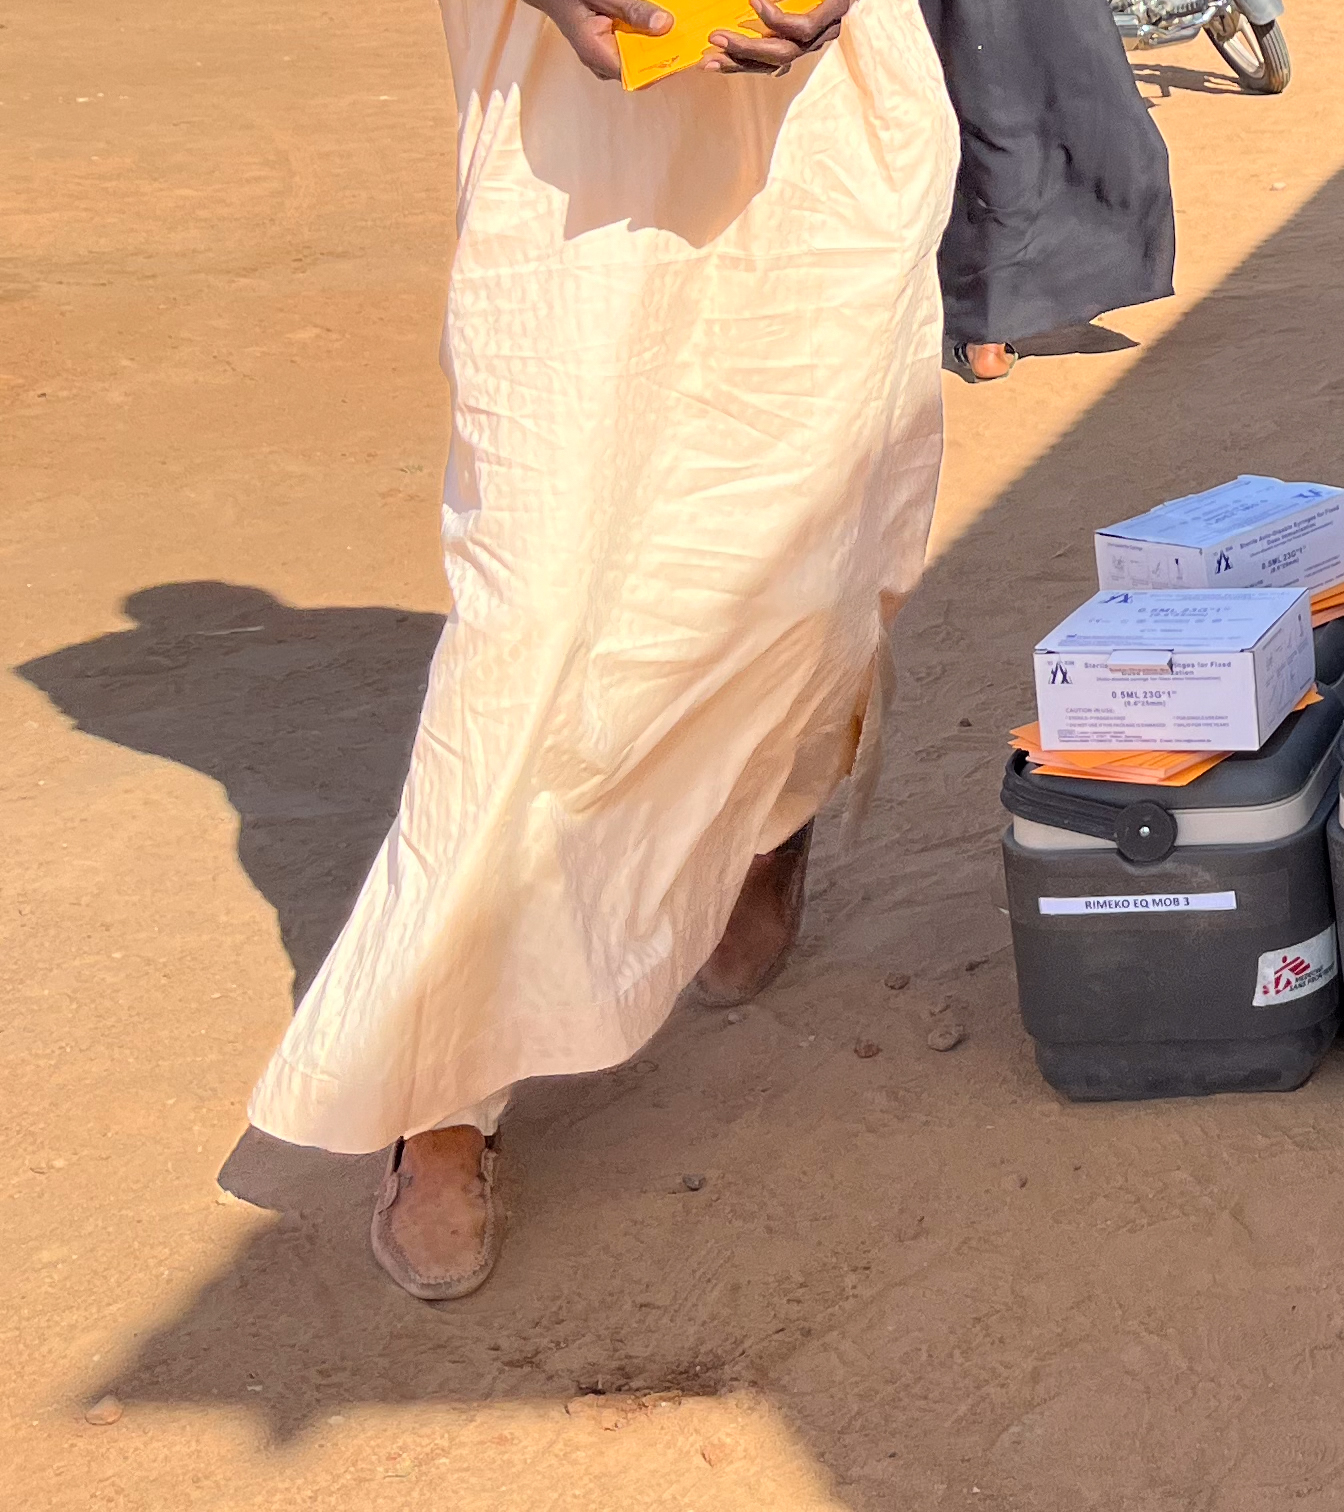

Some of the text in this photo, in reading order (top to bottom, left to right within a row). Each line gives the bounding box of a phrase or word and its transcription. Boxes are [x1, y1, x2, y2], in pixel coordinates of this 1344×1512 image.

[1084, 897, 1190, 910] RIMEKO EQ MOB 3
